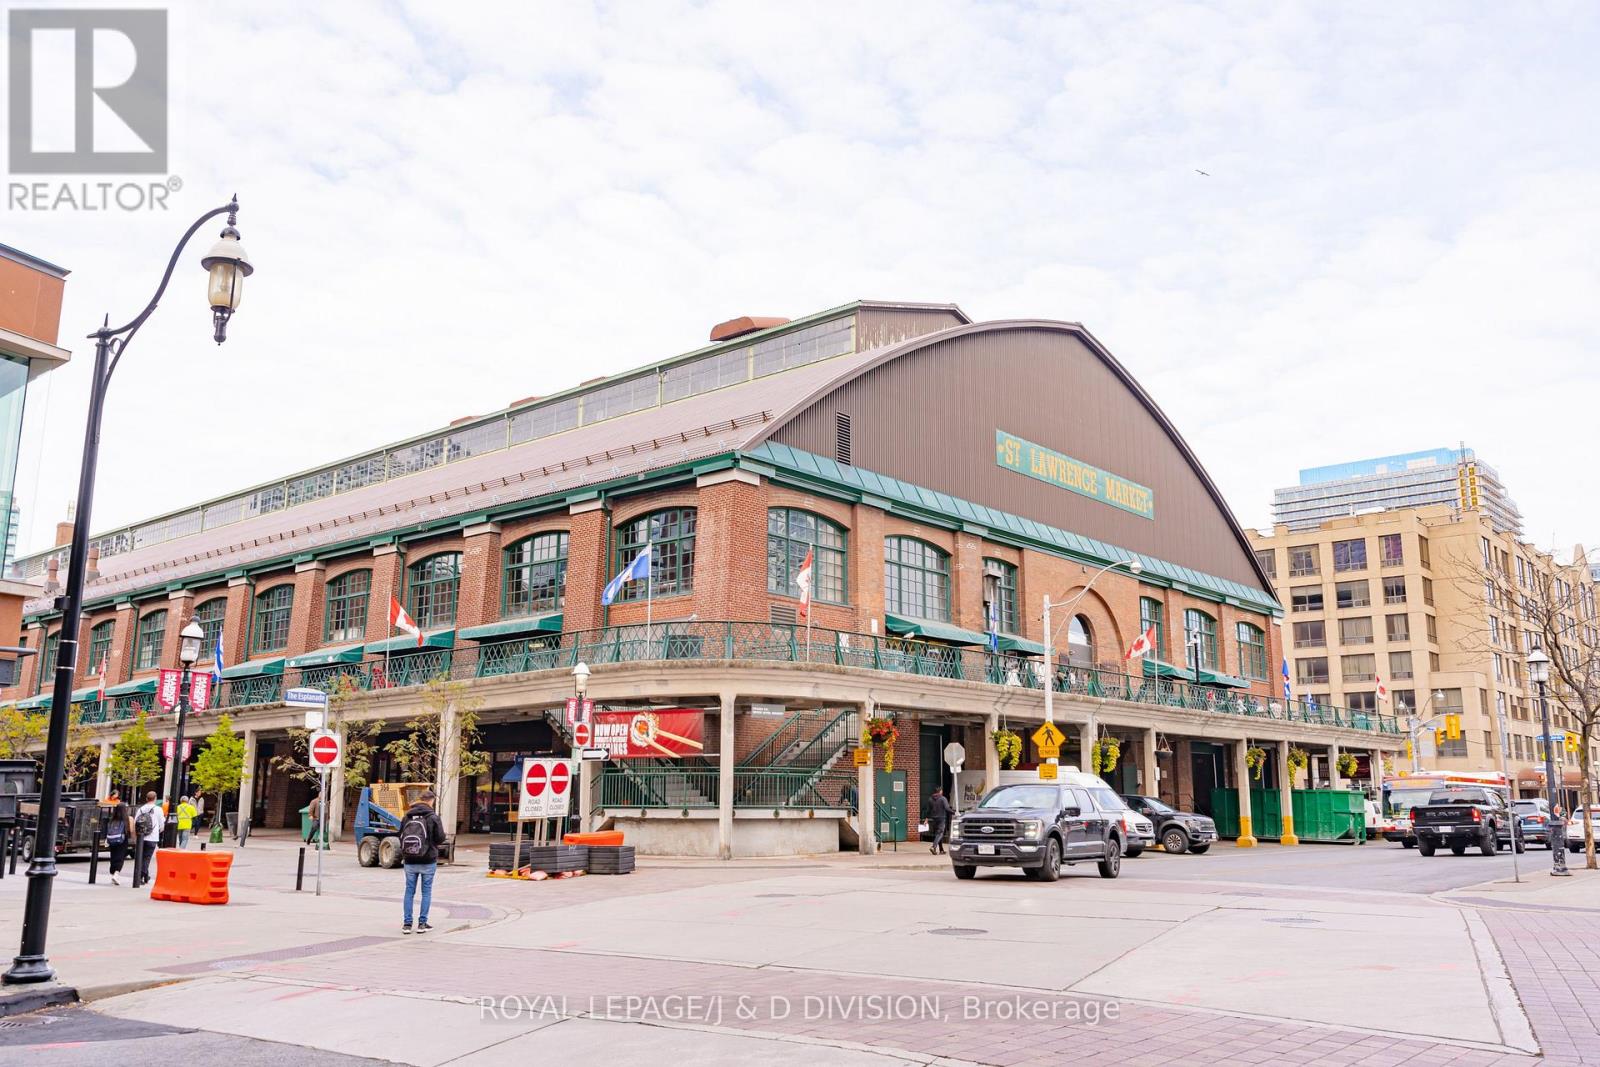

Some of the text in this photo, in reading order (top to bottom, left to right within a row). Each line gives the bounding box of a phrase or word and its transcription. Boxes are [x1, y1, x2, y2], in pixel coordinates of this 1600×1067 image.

[1005, 438, 1149, 514] ST LAWRENCE MARKET
[287, 691, 326, 702] The Esplanade
[595, 723, 628, 737] NOW OPEN
